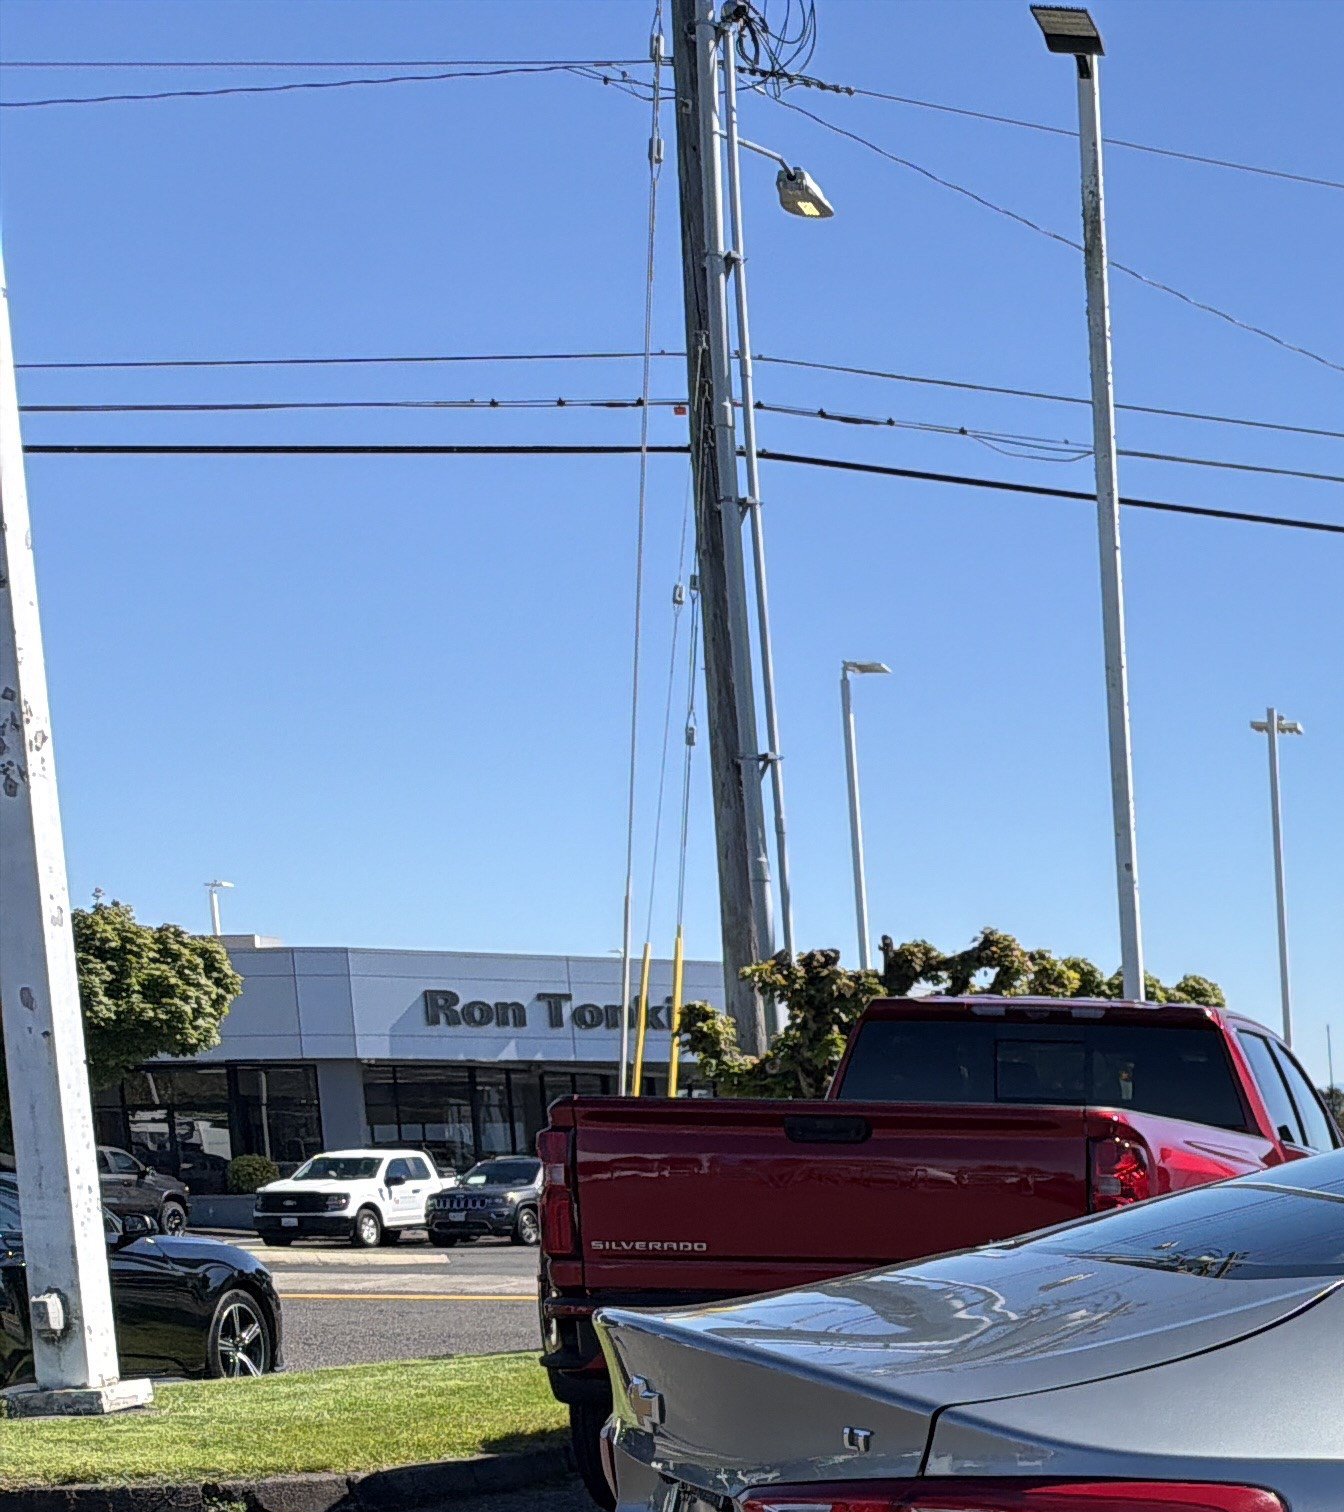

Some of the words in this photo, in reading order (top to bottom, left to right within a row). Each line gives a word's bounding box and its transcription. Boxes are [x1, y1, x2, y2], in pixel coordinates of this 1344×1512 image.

[422, 988, 528, 1028] Ron
[535, 992, 674, 1031] Tonki
[590, 1240, 708, 1252] SILVERADO
[843, 1427, 872, 1452] LT
